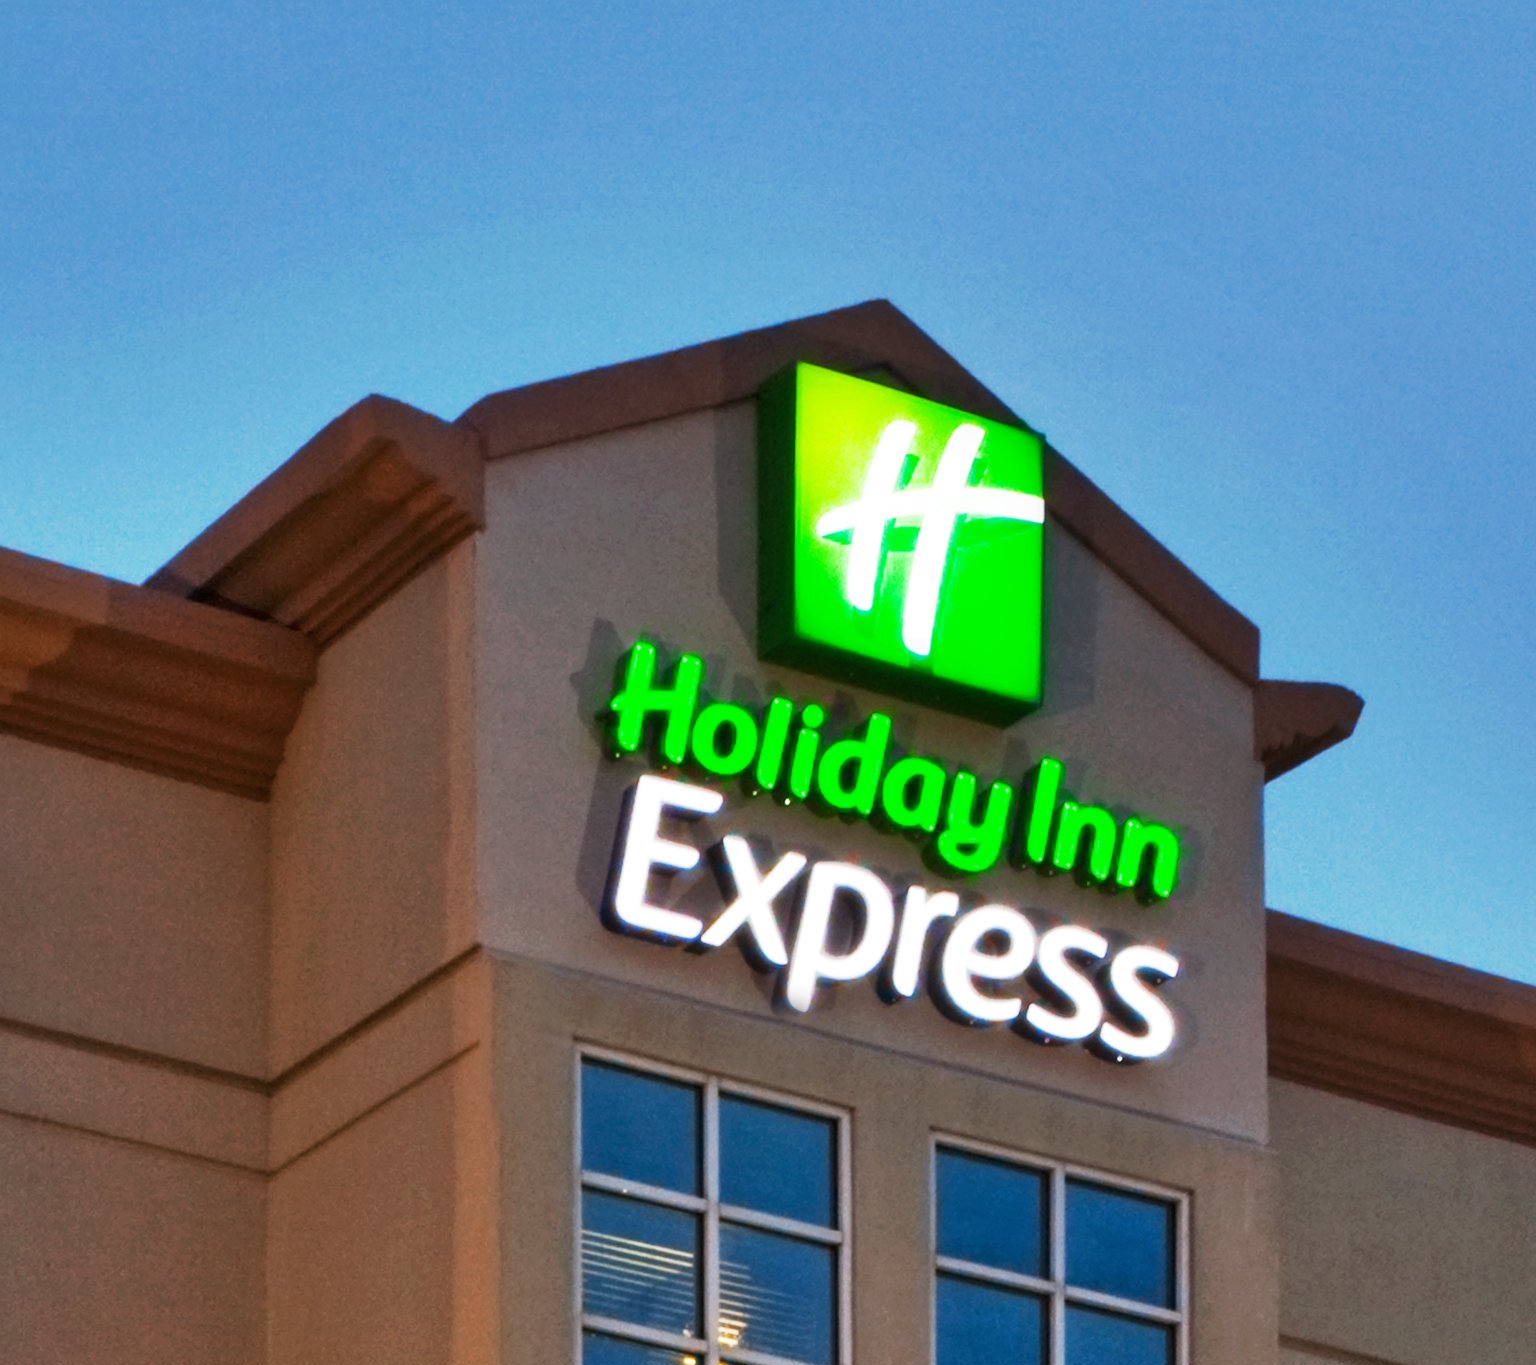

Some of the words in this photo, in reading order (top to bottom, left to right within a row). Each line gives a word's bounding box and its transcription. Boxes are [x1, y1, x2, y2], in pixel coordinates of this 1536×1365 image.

[815, 418, 1046, 656] H
[610, 640, 1013, 872] Holiday
[1026, 756, 1180, 899] Inn
[612, 772, 1180, 1060] Express
